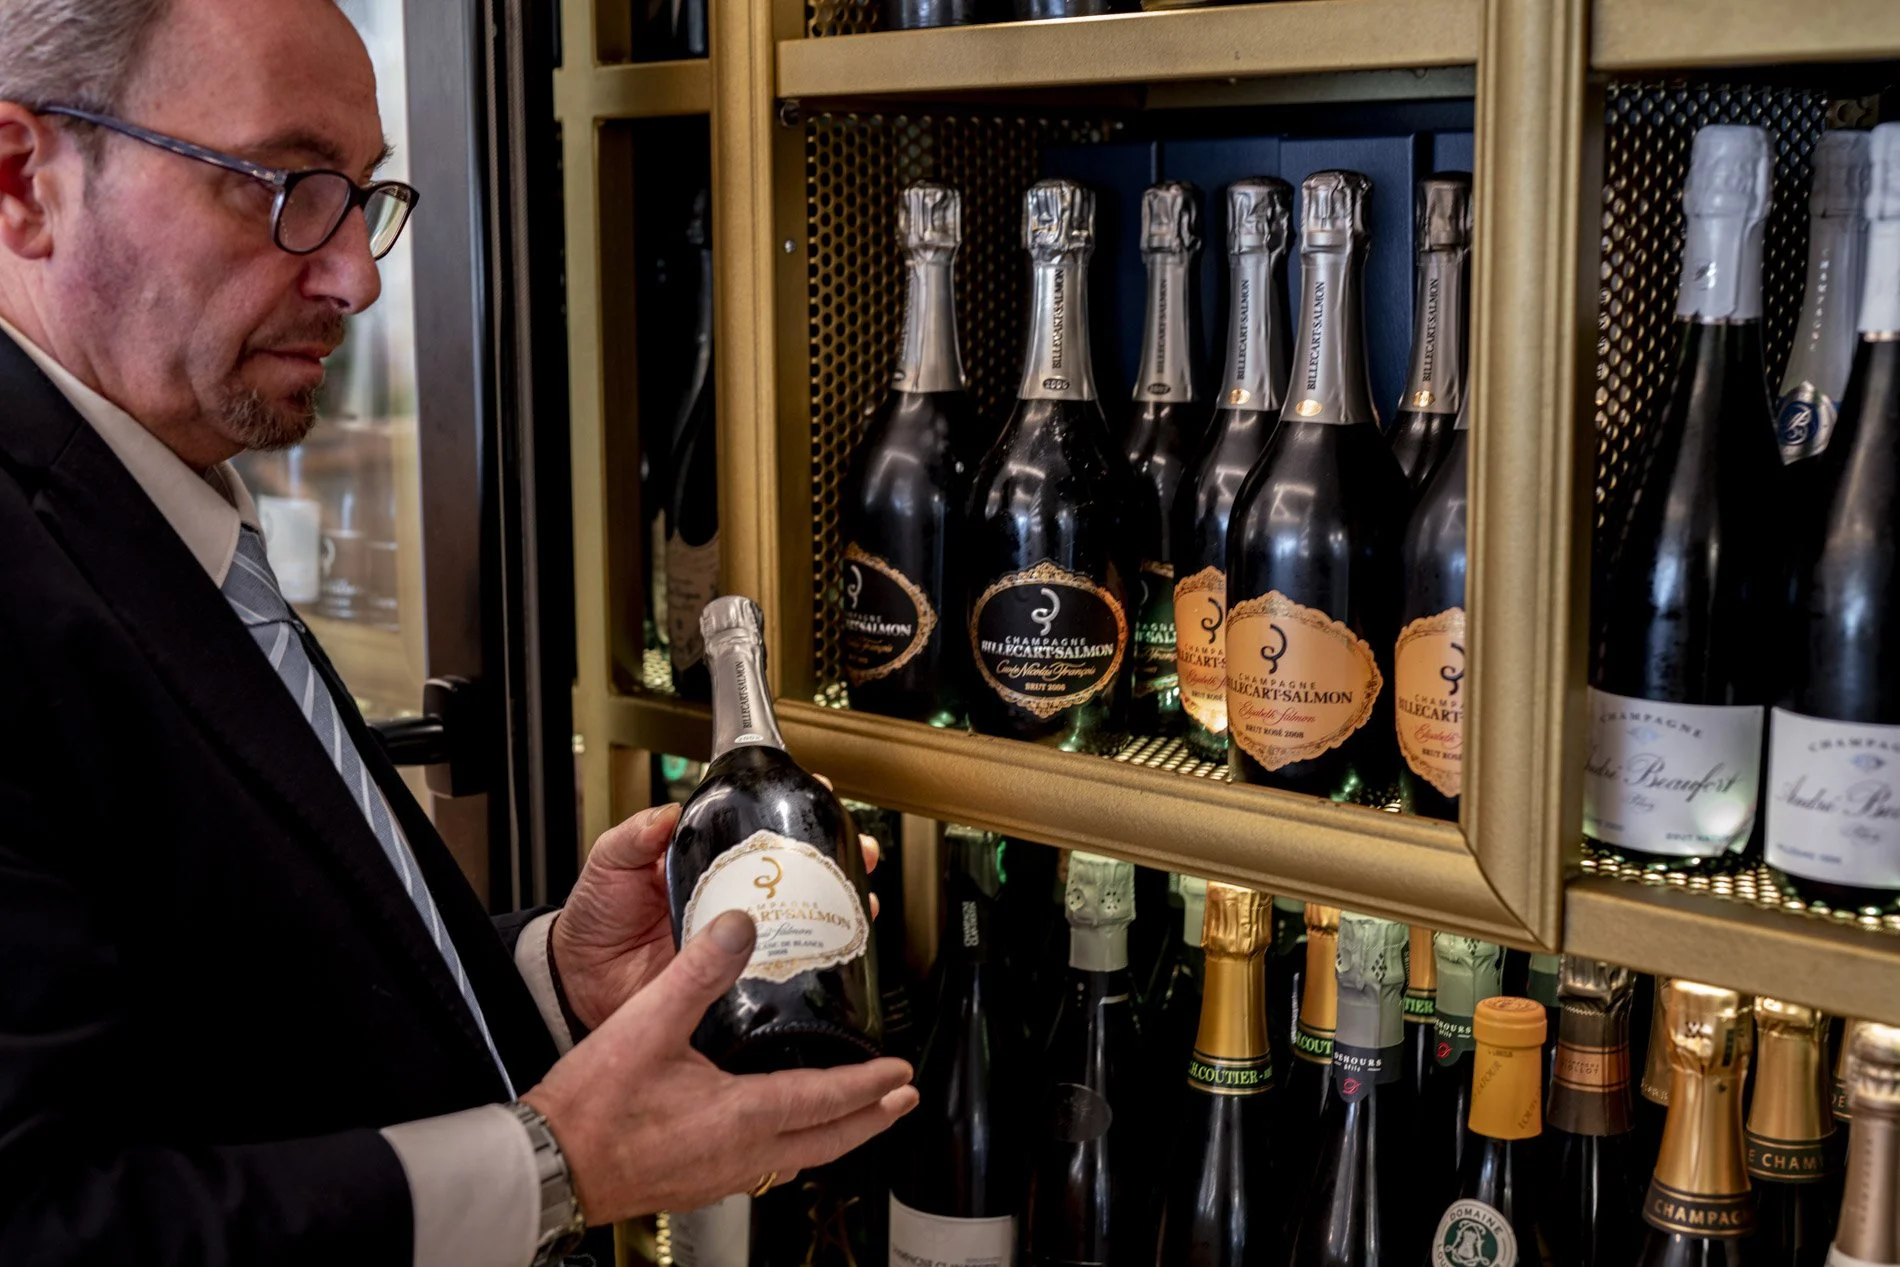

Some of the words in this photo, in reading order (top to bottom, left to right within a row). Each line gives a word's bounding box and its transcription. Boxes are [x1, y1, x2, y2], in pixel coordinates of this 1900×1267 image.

[1005, 635, 1086, 646] CHAMPAGNE
[1184, 644, 1224, 656] CHAMPA
[1239, 673, 1316, 690] CHAMPAGNE
[1264, 707, 1317, 726] Salmon
[1600, 711, 1703, 739] CHAMPAGNE
[1245, 724, 1262, 734] BRUT
[1623, 752, 1742, 803] Beaufort
[1449, 1207, 1504, 1237] DOMAINE
